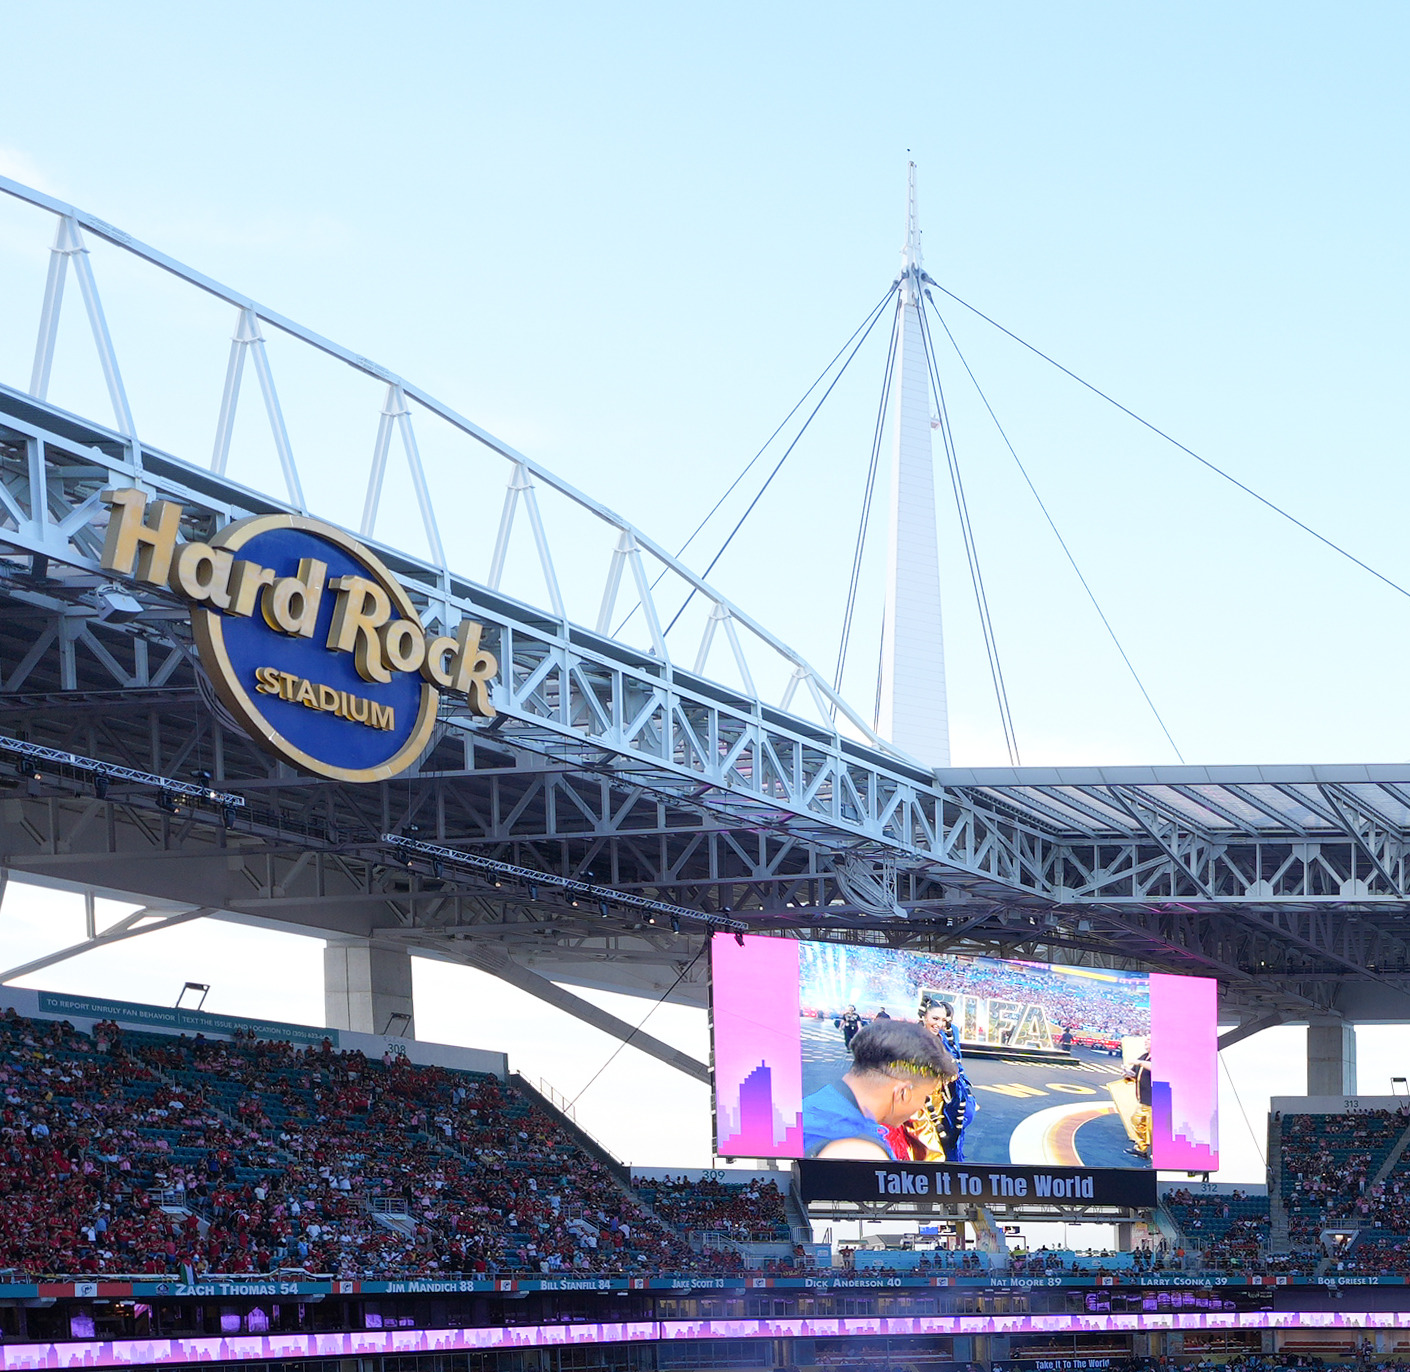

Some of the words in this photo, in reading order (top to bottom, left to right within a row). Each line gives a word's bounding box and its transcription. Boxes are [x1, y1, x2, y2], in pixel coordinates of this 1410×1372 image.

[100, 486, 327, 640] Hard
[329, 574, 498, 718] Rock
[256, 666, 396, 732] STADIUM
[47, 998, 58, 1007] TO
[60, 1000, 90, 1010] REPORT
[91, 1004, 121, 1014] UNRULY
[122, 1008, 138, 1016] FAN
[139, 1011, 176, 1021] BEHAVIOR
[183, 1016, 199, 1024] TEXT
[200, 1018, 213, 1026] THE
[214, 1020, 232, 1029] ISSUE
[387, 1043, 406, 1054] 308
[1344, 1100, 1359, 1109] 313
[702, 1170, 726, 1180] 309
[875, 1170, 929, 1196] Take
[935, 1171, 952, 1196] It
[957, 1172, 983, 1197] To
[988, 1173, 1028, 1198] The
[1033, 1174, 1095, 1199] World
[1200, 1183, 1218, 1193] 312
[540, 1280, 558, 1290] BILL
[560, 1280, 597, 1290] STANFILL
[598, 1280, 611, 1290] 84
[671, 1280, 689, 1289] JAKE
[690, 1280, 714, 1289] SCOTT
[715, 1280, 724, 1288] 13
[805, 1279, 828, 1289] DICK
[833, 1279, 884, 1288] ANDERSON
[887, 1279, 902, 1288] 40
[990, 1278, 1007, 1287] NAT
[1010, 1278, 1044, 1287] MOORE
[1047, 1277, 1062, 1287] 89
[1141, 1277, 1170, 1287] LARRY
[1173, 1277, 1212, 1286] CSONKA
[1214, 1278, 1228, 1286] 39
[1317, 1277, 1336, 1286] BOB
[1338, 1277, 1366, 1286] GRIESE
[1368, 1277, 1379, 1286] 12
[174, 1283, 218, 1295] ZACH
[221, 1284, 276, 1295] THOMAS
[280, 1284, 298, 1295] 54
[385, 1282, 405, 1293] JIM
[408, 1282, 457, 1292] MANDICH
[459, 1281, 474, 1292] 88
[1035, 1360, 1054, 1370] Take
[1063, 1360, 1072, 1370] To
[1073, 1360, 1087, 1370] The
[1088, 1359, 1110, 1370] World
